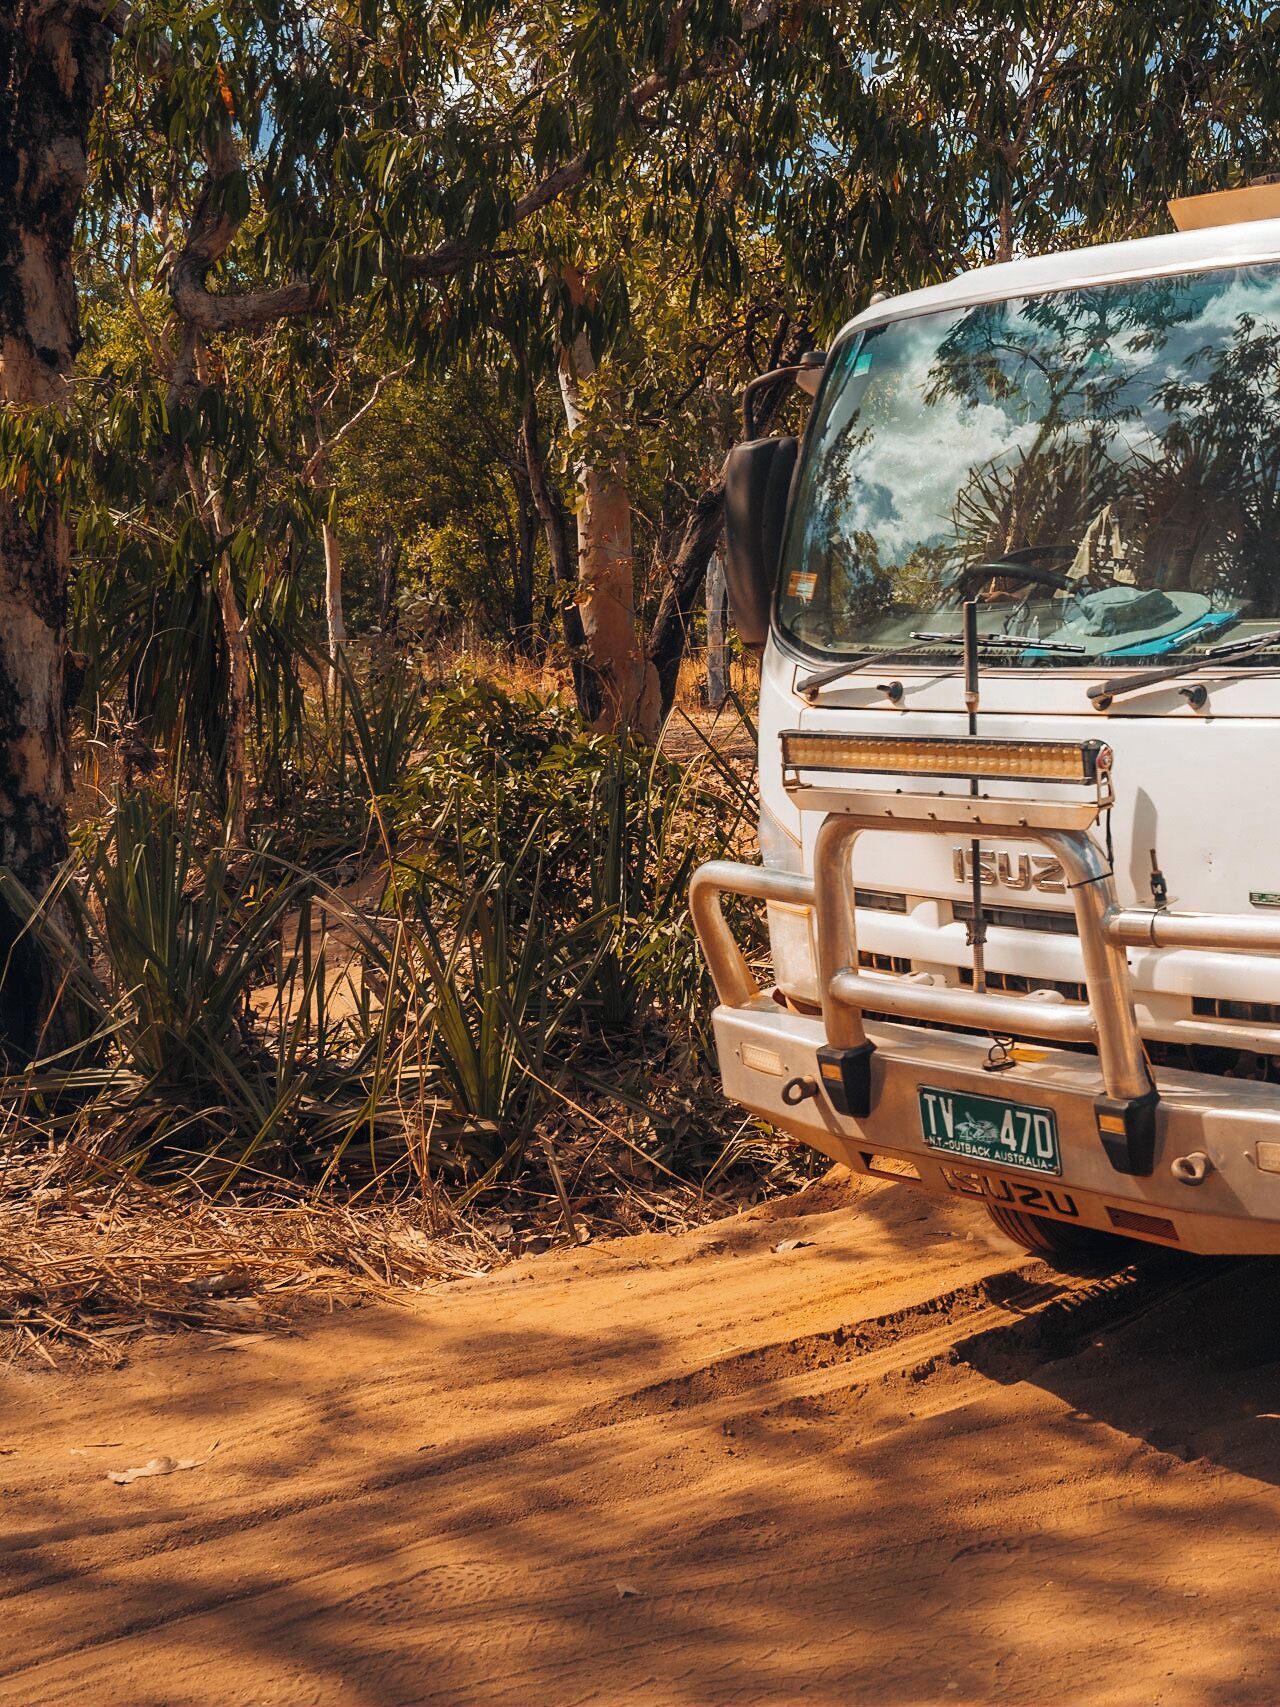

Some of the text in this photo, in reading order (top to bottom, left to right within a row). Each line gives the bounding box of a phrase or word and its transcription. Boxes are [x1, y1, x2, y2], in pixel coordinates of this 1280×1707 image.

[952, 847, 1067, 894] ISUZ
[923, 1093, 954, 1139] TV
[939, 1166, 1080, 1217] ISUZU
